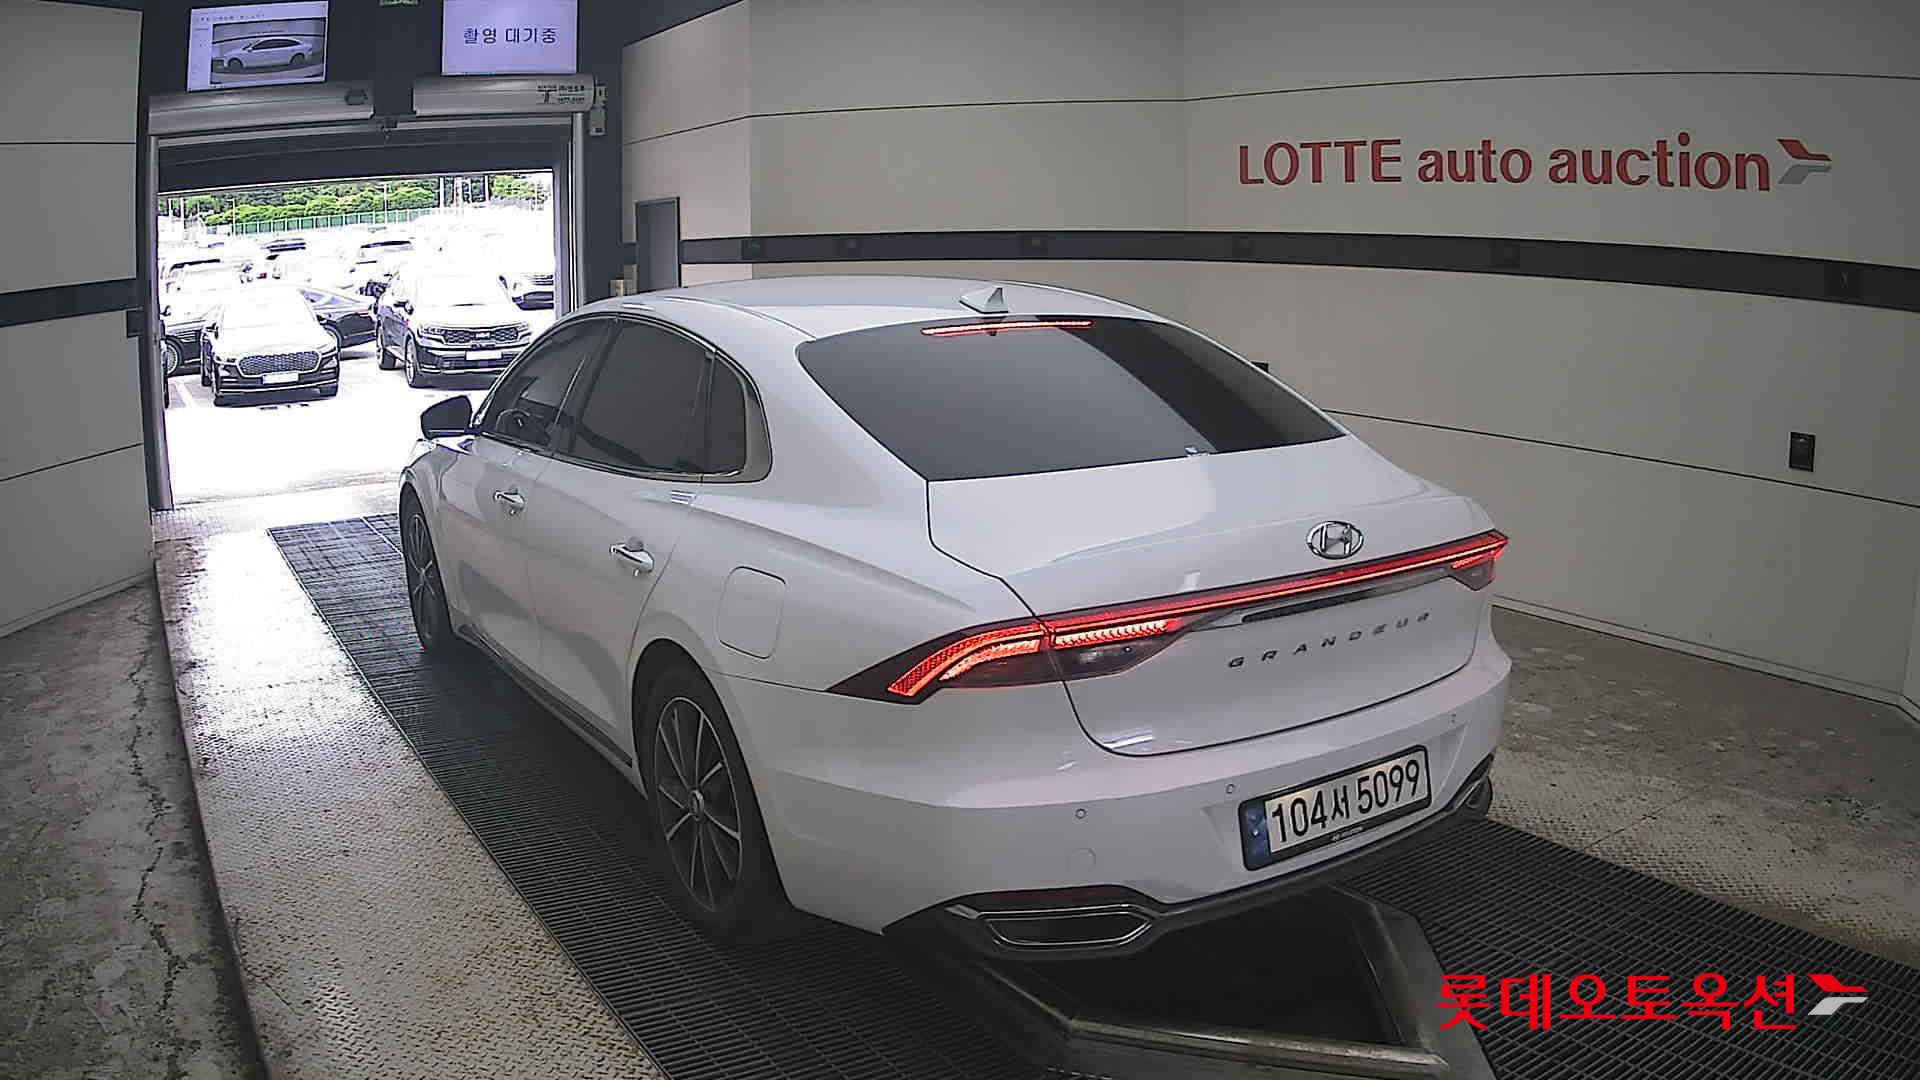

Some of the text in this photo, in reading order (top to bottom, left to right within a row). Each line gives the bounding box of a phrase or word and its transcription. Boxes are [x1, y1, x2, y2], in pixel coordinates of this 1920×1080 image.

[463, 27, 558, 44] 촬영 대기중
[1239, 131, 1771, 192] LOTTE auto auction
[1228, 612, 1430, 668] GRANDEUR
